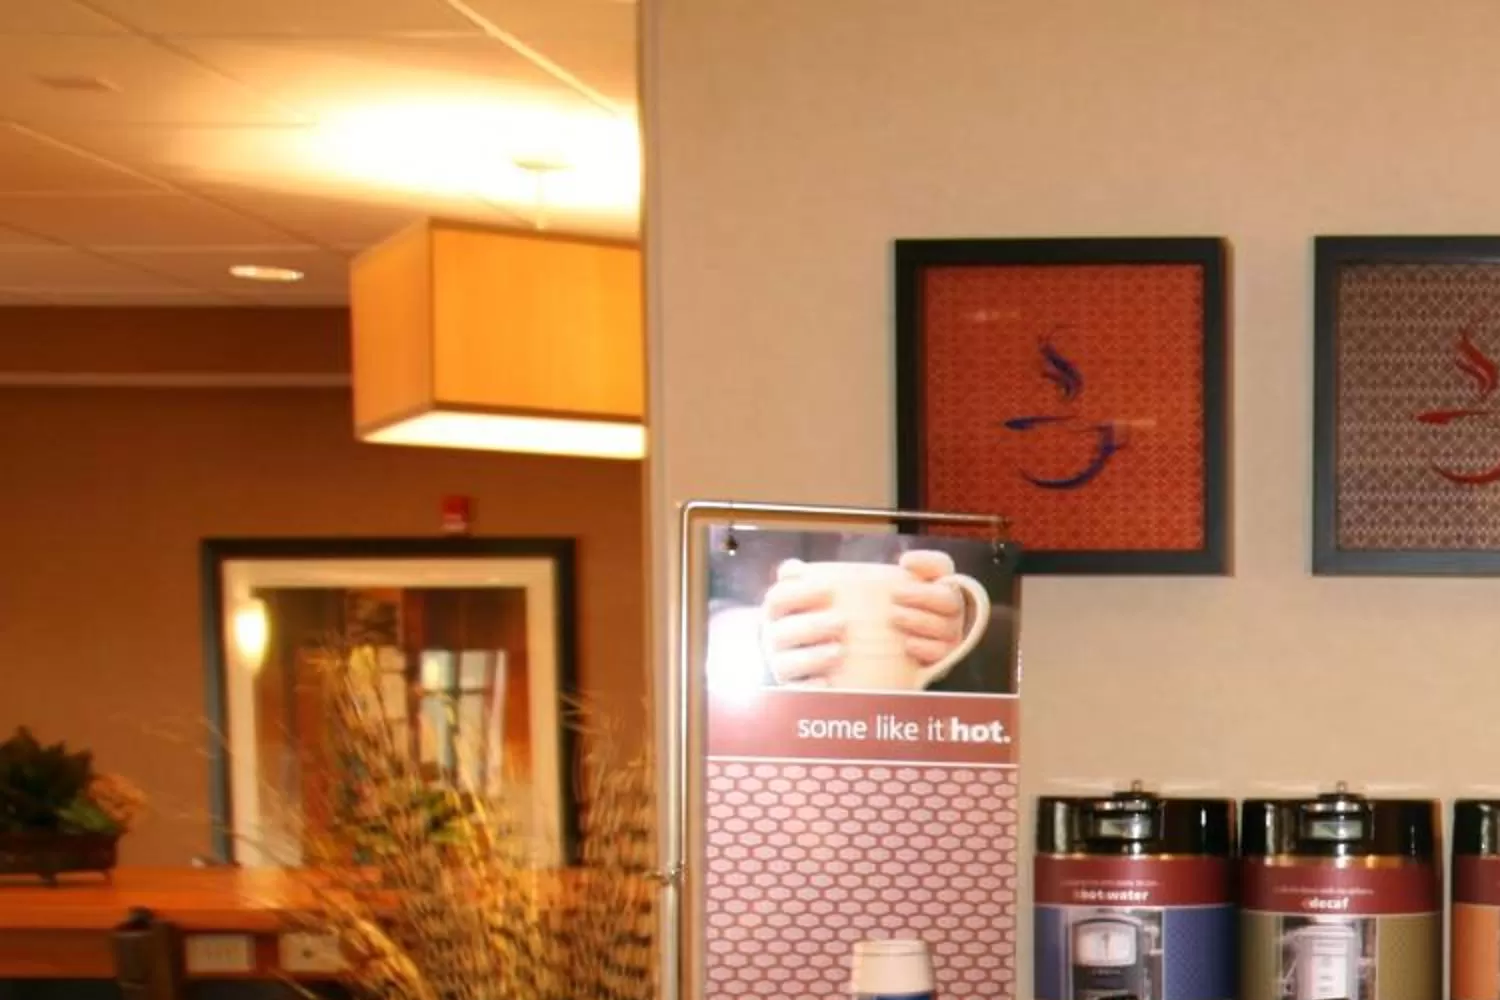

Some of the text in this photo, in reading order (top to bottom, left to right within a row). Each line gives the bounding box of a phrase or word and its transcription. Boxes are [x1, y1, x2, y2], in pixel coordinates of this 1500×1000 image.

[797, 713, 1012, 743] some like it hot.
[1107, 889, 1150, 901] water
[1307, 896, 1350, 910] decaf
